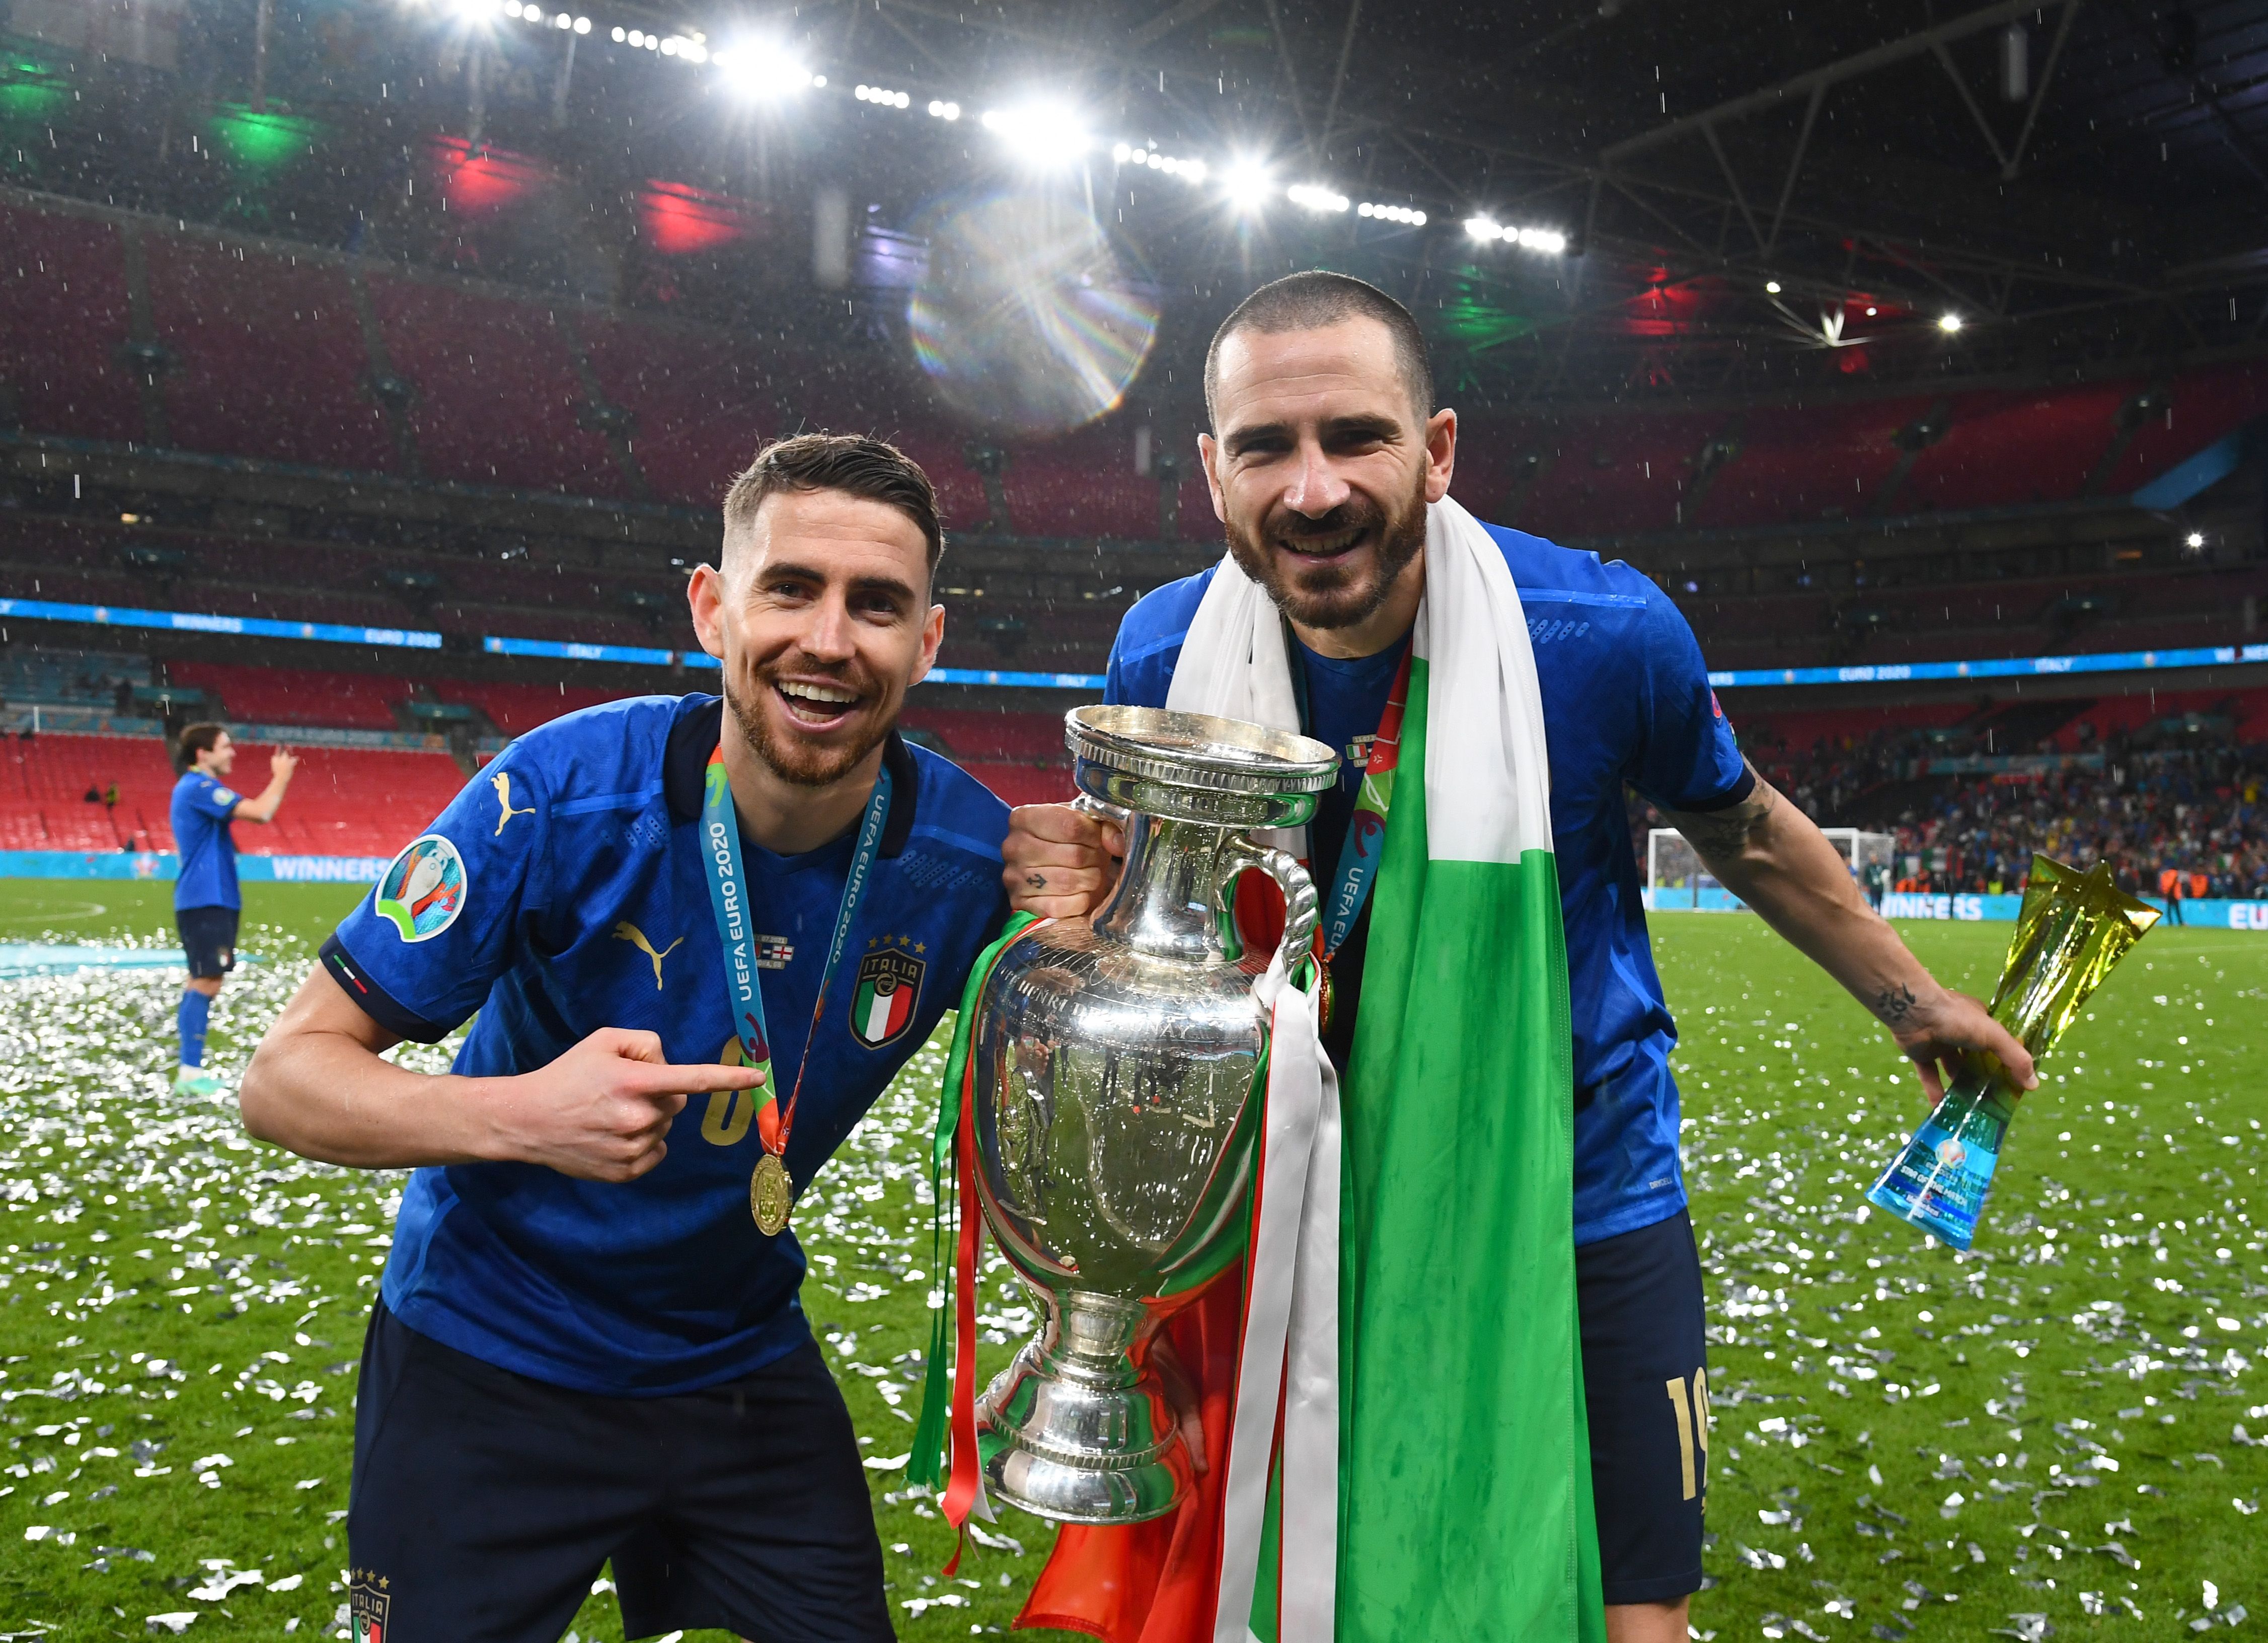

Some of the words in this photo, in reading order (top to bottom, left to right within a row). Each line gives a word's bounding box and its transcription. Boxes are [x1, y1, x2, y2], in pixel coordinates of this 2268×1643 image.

[863, 794, 884, 848] UEFA
[272, 857, 391, 881] WINNERS
[709, 822, 734, 878] 2020
[848, 851, 869, 908] EURO
[1337, 867, 1364, 916] UEFA
[721, 881, 744, 941] EURO
[833, 911, 852, 964] 2020
[1328, 920, 1346, 951] EU
[733, 942, 751, 1001] UEFA
[864, 958, 918, 979] ITALIA
[352, 1593, 383, 1616] ITALIA
